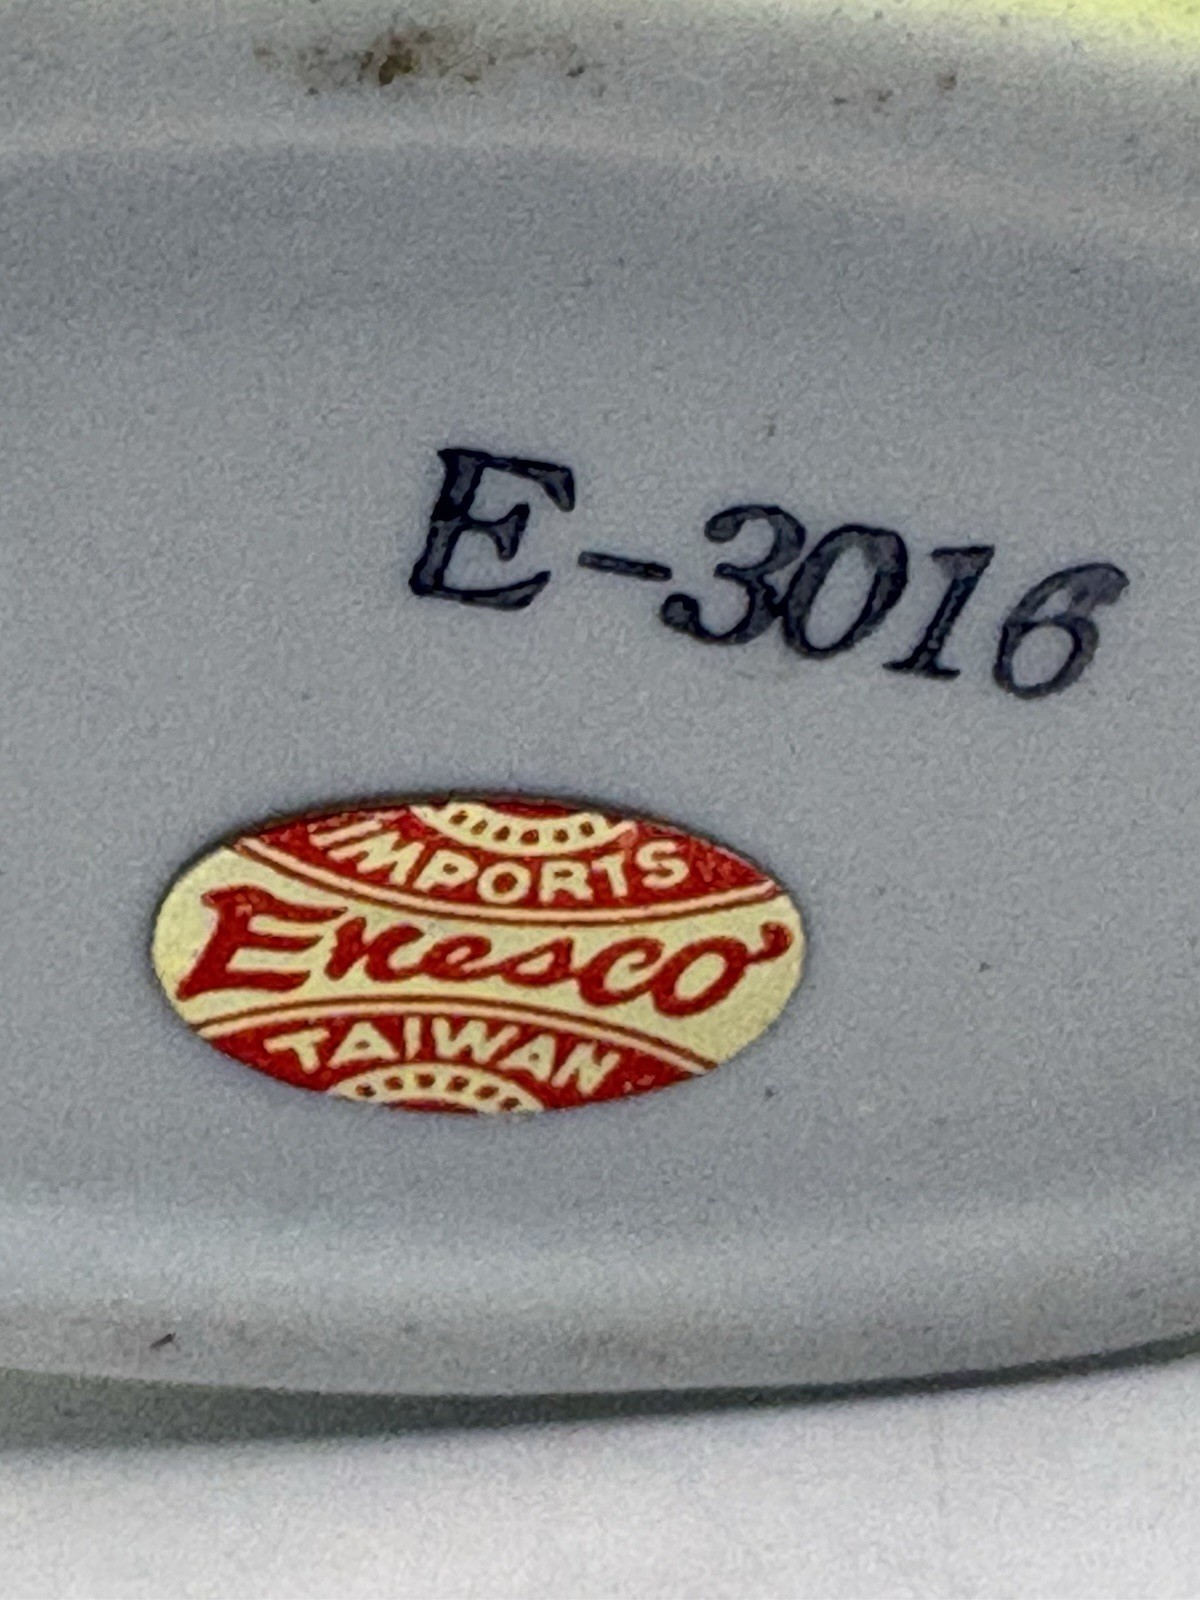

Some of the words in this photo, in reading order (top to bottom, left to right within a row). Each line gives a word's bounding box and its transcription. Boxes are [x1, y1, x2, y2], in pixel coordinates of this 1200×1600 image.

[408, 446, 1129, 699] E-3016
[309, 816, 690, 905] IMPORTS
[176, 885, 793, 1019] Enesco
[264, 1015, 620, 1094] TAIWAN
